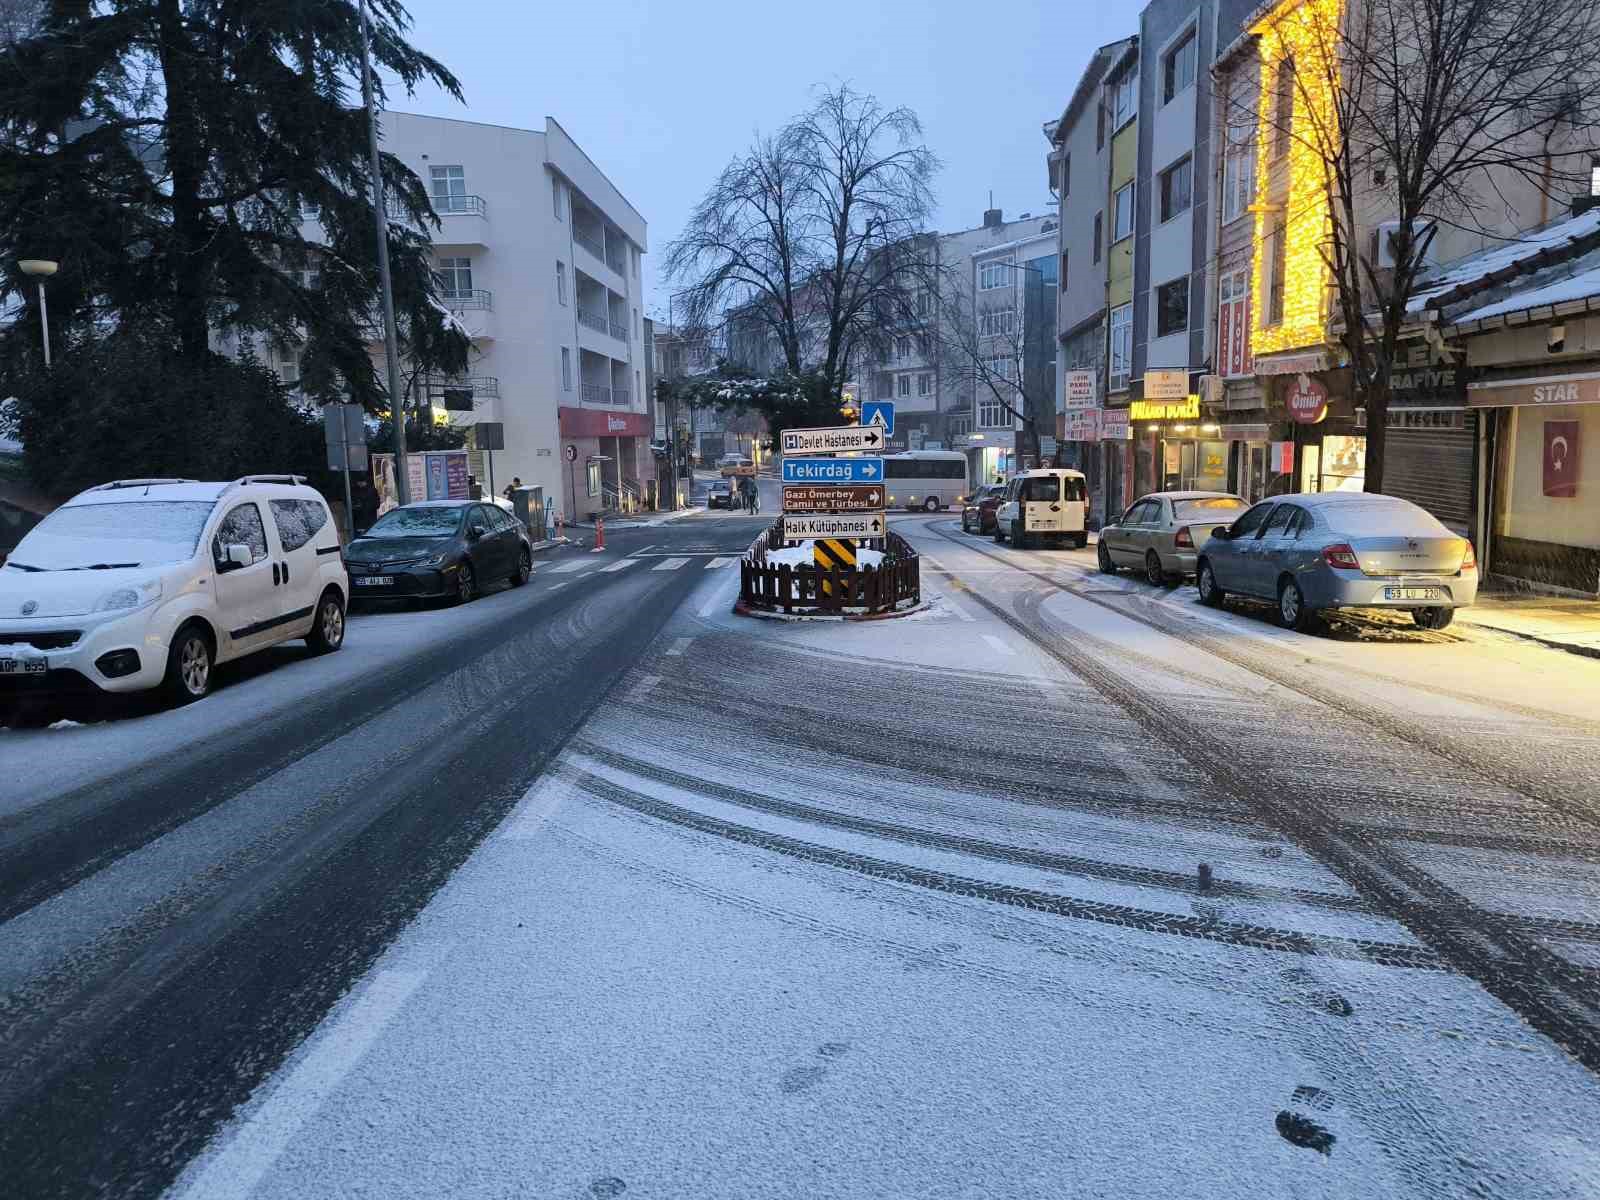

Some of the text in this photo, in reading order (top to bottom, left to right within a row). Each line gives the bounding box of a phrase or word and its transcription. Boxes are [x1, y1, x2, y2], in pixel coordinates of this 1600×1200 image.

[1533, 384, 1578, 402] STAR
[799, 435, 823, 449] Devlet
[824, 433, 862, 448] Hastanesi
[787, 463, 853, 480] Tekirdağ
[785, 488, 854, 500] Gazi Ömerbey
[785, 519, 868, 535] Halk Kütüphanesi
